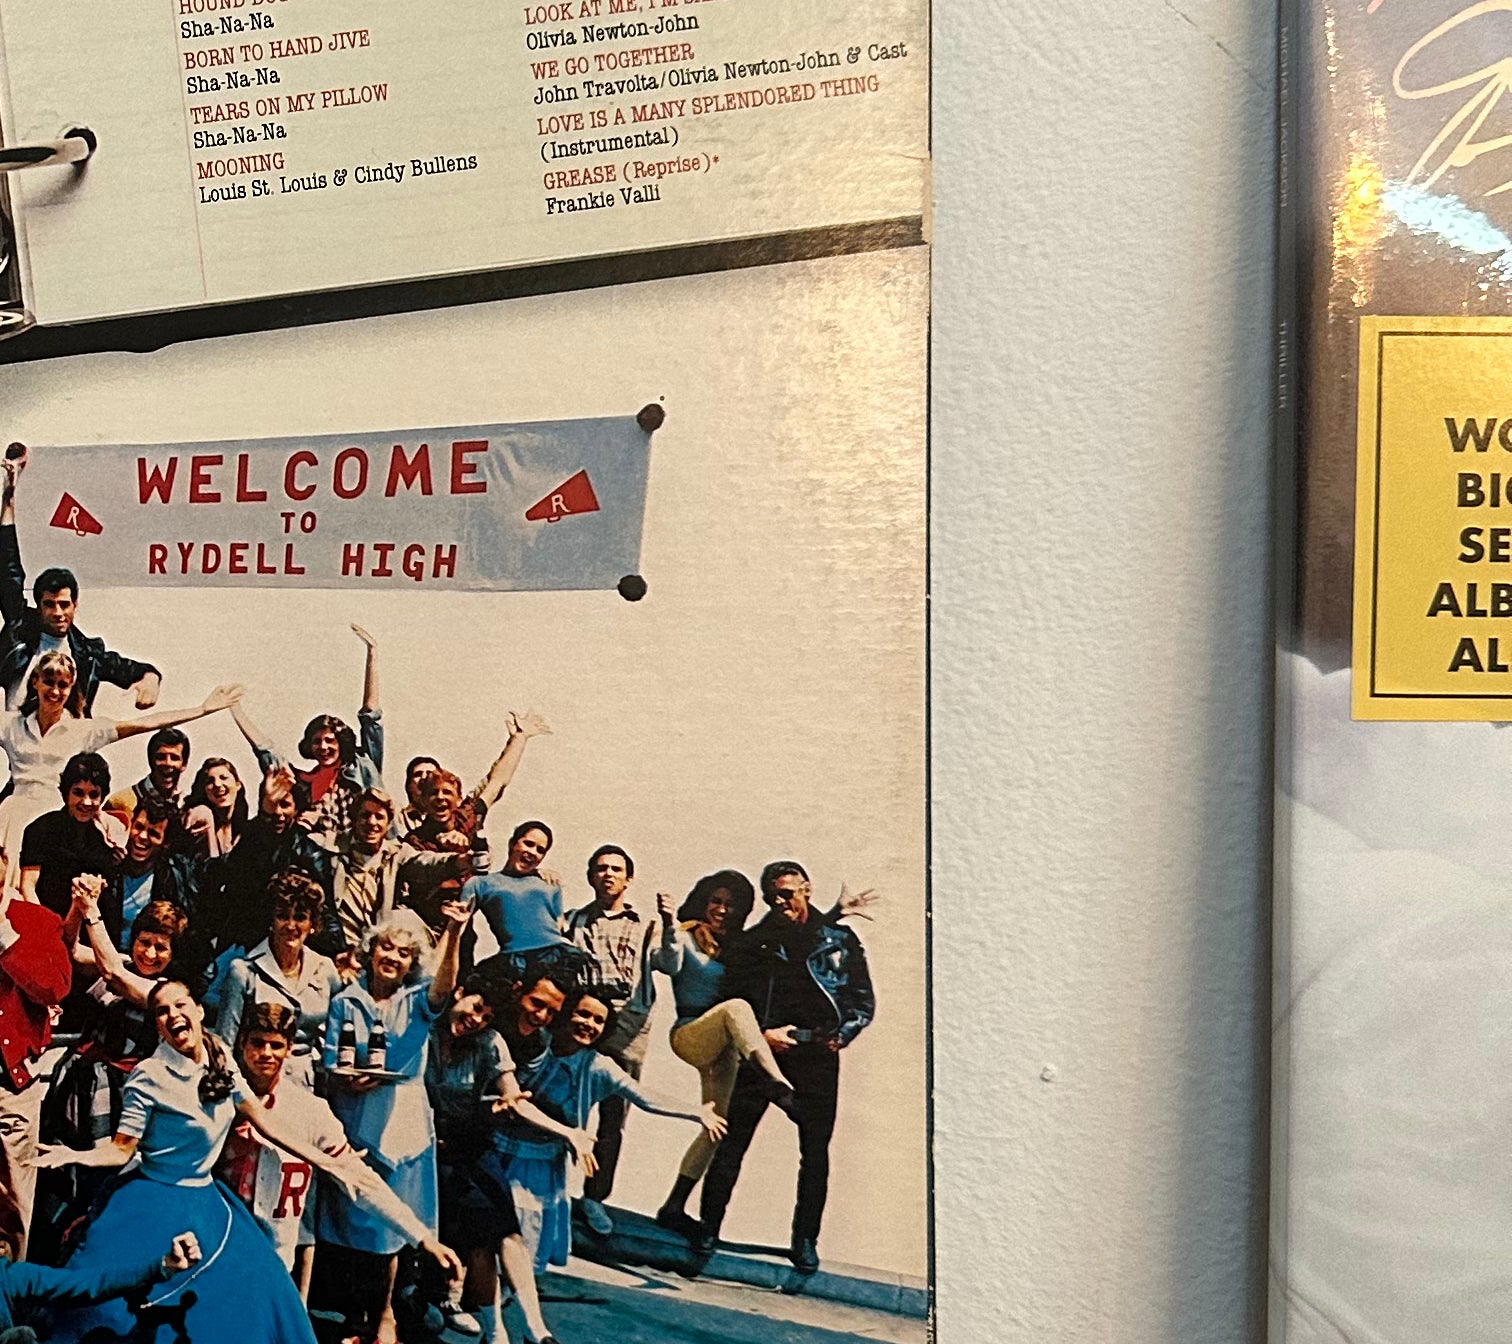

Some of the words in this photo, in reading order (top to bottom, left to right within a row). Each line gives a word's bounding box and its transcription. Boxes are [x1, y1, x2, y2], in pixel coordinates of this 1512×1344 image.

[181, 12, 274, 38] Sha-Na-Na
[526, 29, 577, 50] Olivia
[581, 14, 700, 43] Newton-John
[183, 46, 234, 70] BORN
[240, 44, 263, 62] TO
[269, 36, 322, 59] HAND
[328, 30, 370, 51] JIVE
[530, 60, 559, 80] WE
[565, 56, 589, 75] GO
[594, 43, 694, 72] TOGETHER
[187, 67, 280, 94] Sha-Na-Na
[194, 122, 287, 149] Sha-Na-Na
[541, 126, 678, 163] (Instrumental)
[196, 152, 284, 180] MOONING
[544, 164, 616, 190] GREASE
[545, 191, 614, 214] Frankie
[619, 184, 661, 205] Valli
[138, 442, 488, 503] WELCOME
[551, 493, 568, 513] R
[1457, 472, 1512, 507] BI
[281, 512, 316, 533] TO
[149, 543, 304, 575] RYDELL
[343, 544, 456, 581] HIGH
[272, 1162, 311, 1219] R
